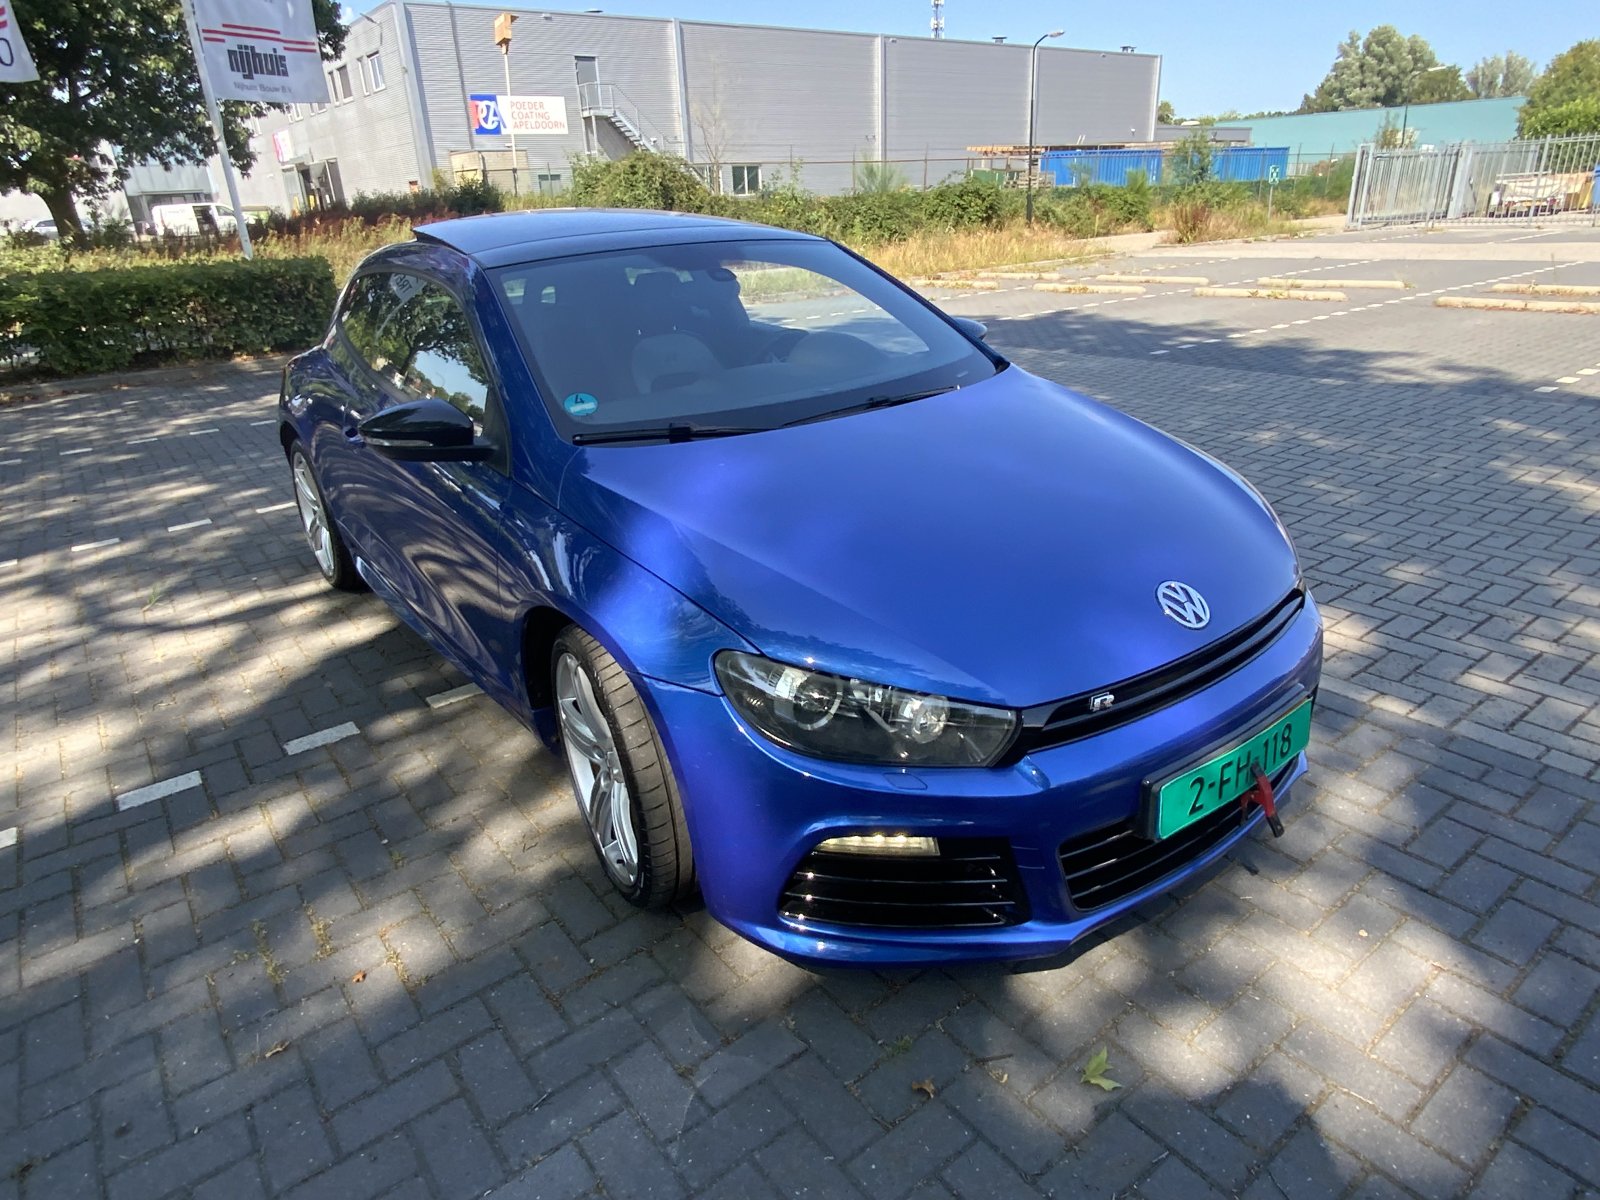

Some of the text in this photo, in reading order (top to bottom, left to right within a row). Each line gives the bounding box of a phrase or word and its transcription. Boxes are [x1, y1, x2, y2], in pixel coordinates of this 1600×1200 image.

[227, 44, 289, 80] nijhuis
[510, 101, 545, 110] POEDER
[511, 111, 551, 120] COATING
[513, 120, 566, 130] APELDOORN
[1090, 691, 1115, 712] R
[1187, 722, 1293, 817] 2-FH-118
